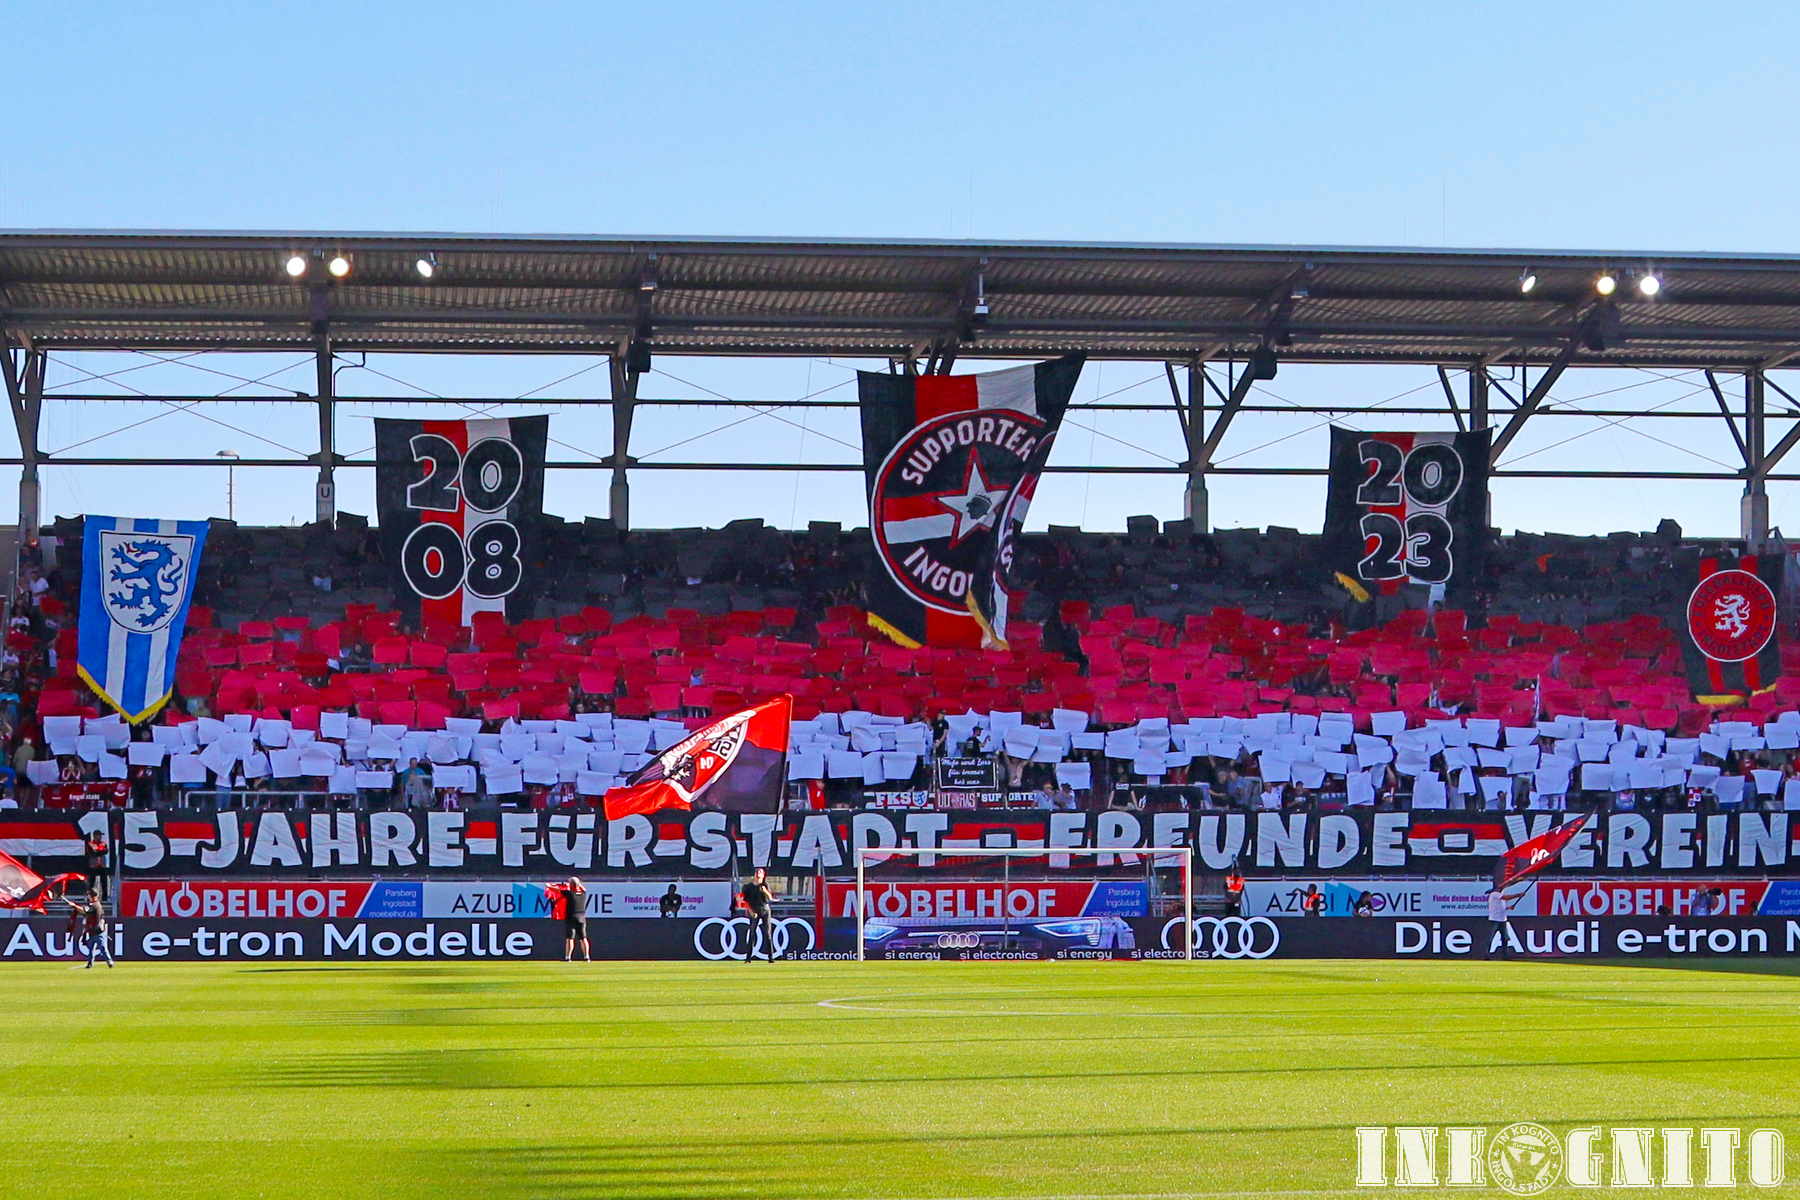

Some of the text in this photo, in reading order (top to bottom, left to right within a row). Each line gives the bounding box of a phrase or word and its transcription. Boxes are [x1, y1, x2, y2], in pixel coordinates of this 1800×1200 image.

[406, 433, 523, 513] 20
[1356, 439, 1464, 508] 20
[321, 487, 330, 498] U
[401, 521, 522, 600] 08
[1357, 511, 1454, 585] 23
[876, 792, 912, 806] FKS
[77, 811, 165, 869] 15
[201, 811, 464, 869] JAHRE
[690, 811, 948, 869] STADT
[1049, 811, 1409, 871] FREUNDE
[1505, 812, 1788, 870] VEREIN
[136, 881, 346, 918] MÖBELHOF
[383, 901, 417, 909] Ingolstadt
[385, 889, 417, 898] Parsberg
[451, 894, 523, 914] AZUBI
[843, 882, 1057, 918] MÖBELHOF
[142, 926, 304, 957] e-tron
[323, 922, 534, 957] Modelle
[973, 950, 1038, 960] electronics
[1395, 921, 1472, 954] Die
[1490, 921, 1600, 954] Audi
[1617, 924, 1768, 954] e-tron
